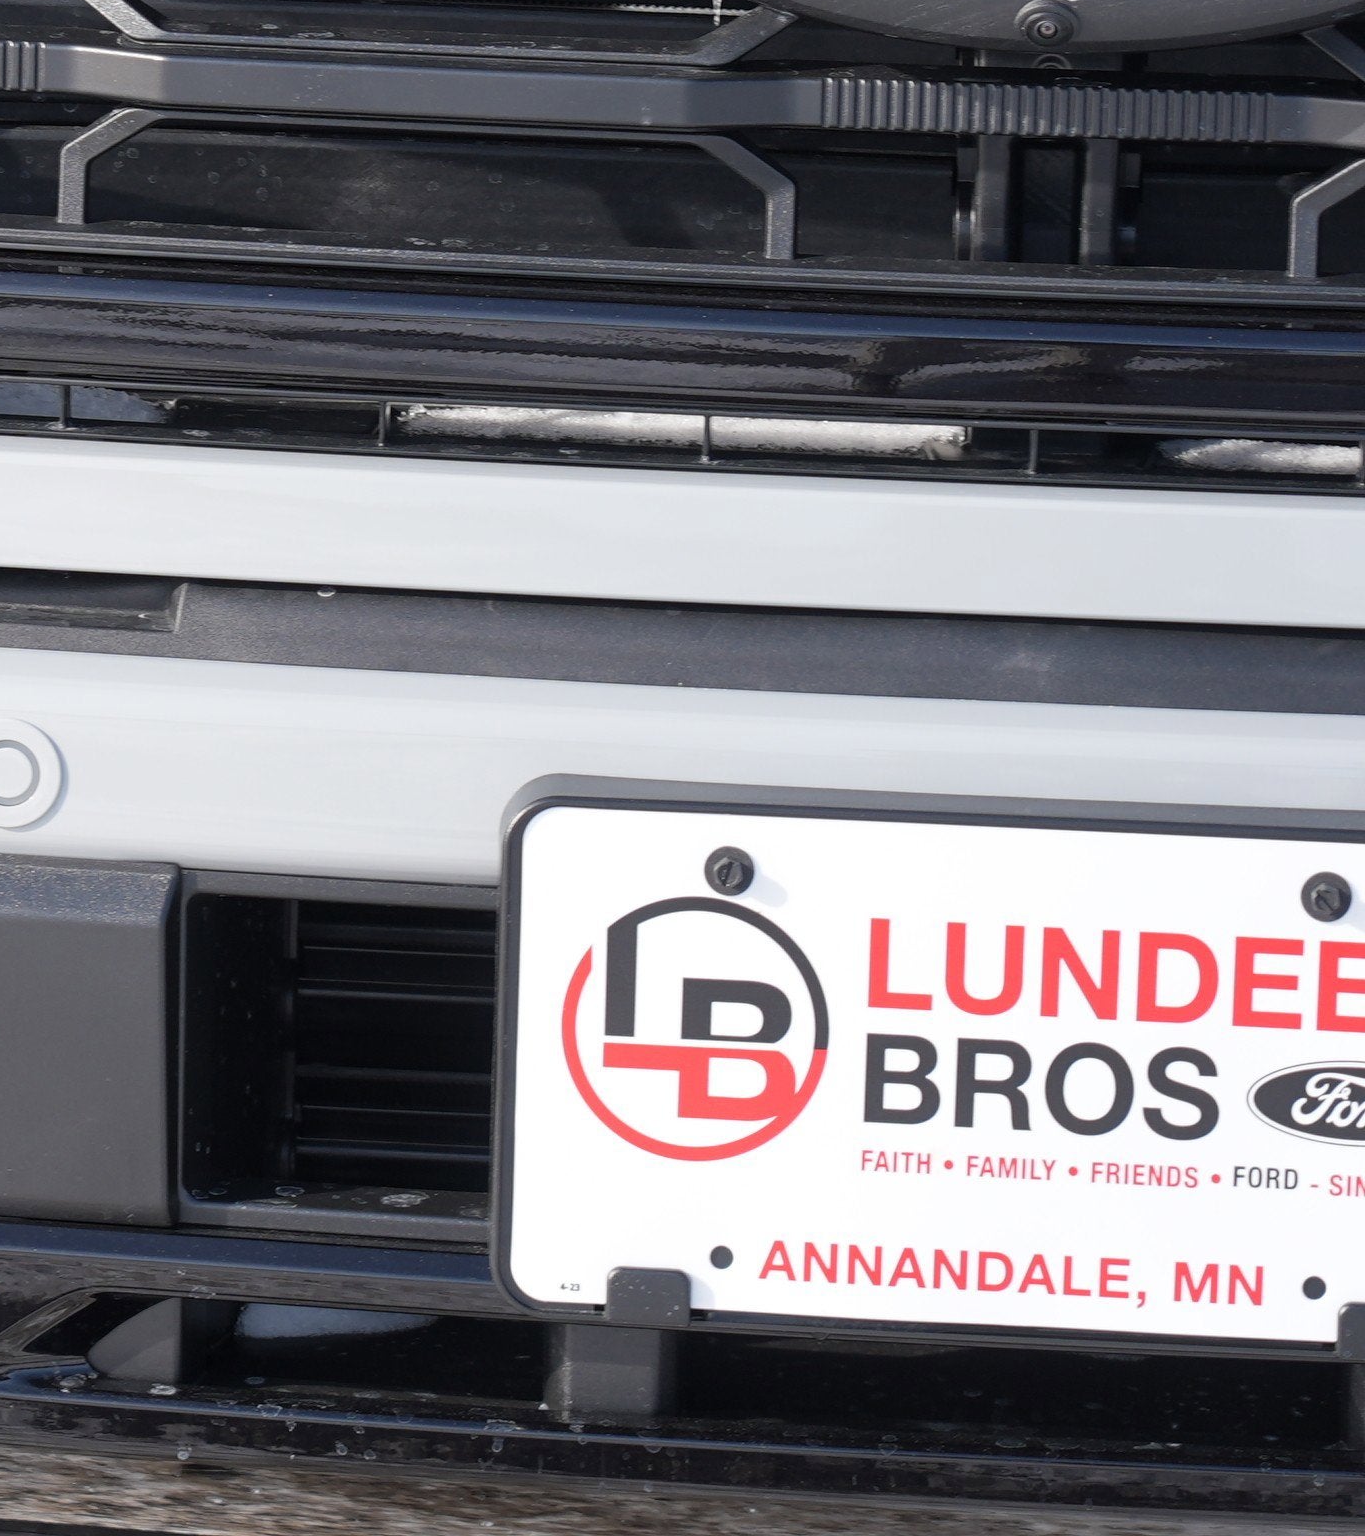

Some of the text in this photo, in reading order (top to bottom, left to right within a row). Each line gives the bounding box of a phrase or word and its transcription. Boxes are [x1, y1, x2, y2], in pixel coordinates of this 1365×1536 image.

[867, 917, 1365, 1033] LUNDEE
[864, 1032, 1220, 1141] BROS
[861, 1149, 931, 1175] FAITH
[967, 1155, 1056, 1181] FAMILY
[1091, 1162, 1199, 1189] FRIENDS
[1233, 1166, 1299, 1190] FORD
[759, 1240, 1264, 1308] ANNANDALE, MN
